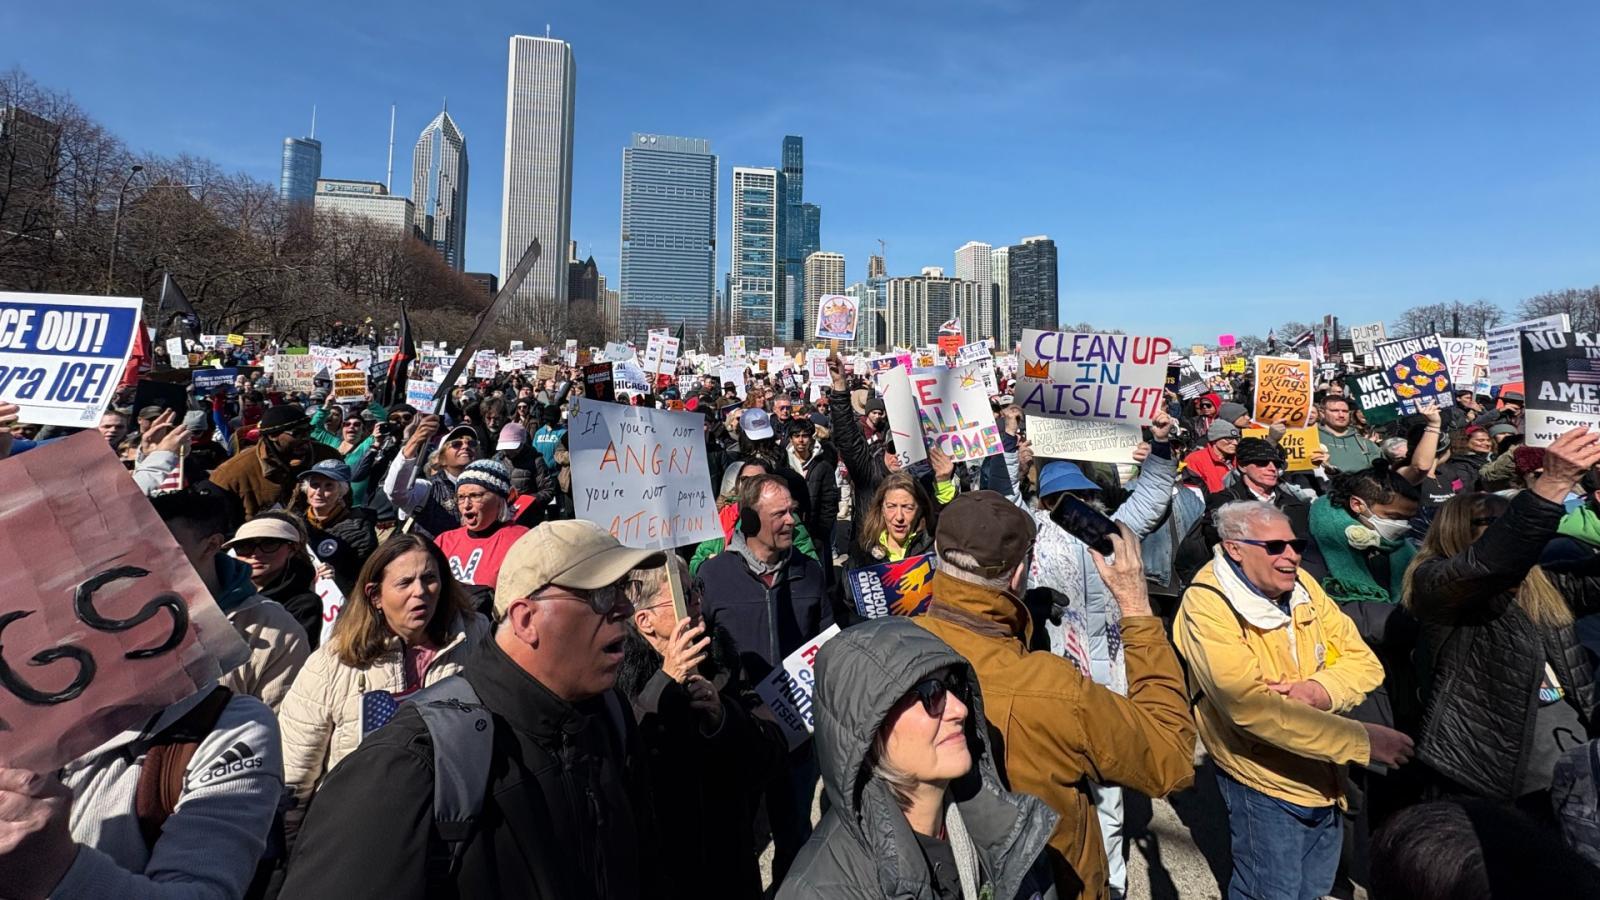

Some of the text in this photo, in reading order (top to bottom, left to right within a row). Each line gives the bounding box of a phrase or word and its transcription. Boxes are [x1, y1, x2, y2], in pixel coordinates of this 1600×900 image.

[37, 310, 110, 353] OUT!
[1353, 325, 1380, 339] DUMP
[1524, 331, 1568, 352] NO
[1035, 332, 1172, 365] CLEAN UP
[1379, 336, 1439, 371] ABOLISH ICE
[1075, 363, 1120, 384] IN
[1263, 363, 1294, 376] No
[45, 361, 114, 403] ICE!
[345, 388, 365, 396] KINGS
[1260, 375, 1308, 393] Kings
[1357, 373, 1384, 393] WE
[1021, 384, 1132, 419] AISLE
[1130, 387, 1163, 419] 47
[1260, 390, 1307, 406] Since
[1360, 388, 1398, 410] BACK
[919, 402, 979, 434] ALL
[1260, 405, 1304, 422] 1776
[1545, 416, 1593, 428] Power
[581, 411, 696, 445] If you're NOT
[1043, 439, 1089, 455] ORANGE
[1090, 438, 1118, 450] THEY
[1283, 434, 1304, 446] the
[599, 440, 694, 476] ANGRY
[585, 481, 707, 512] you're NOT paying
[771, 698, 805, 733] ITSELF
[200, 755, 262, 783] adidas
